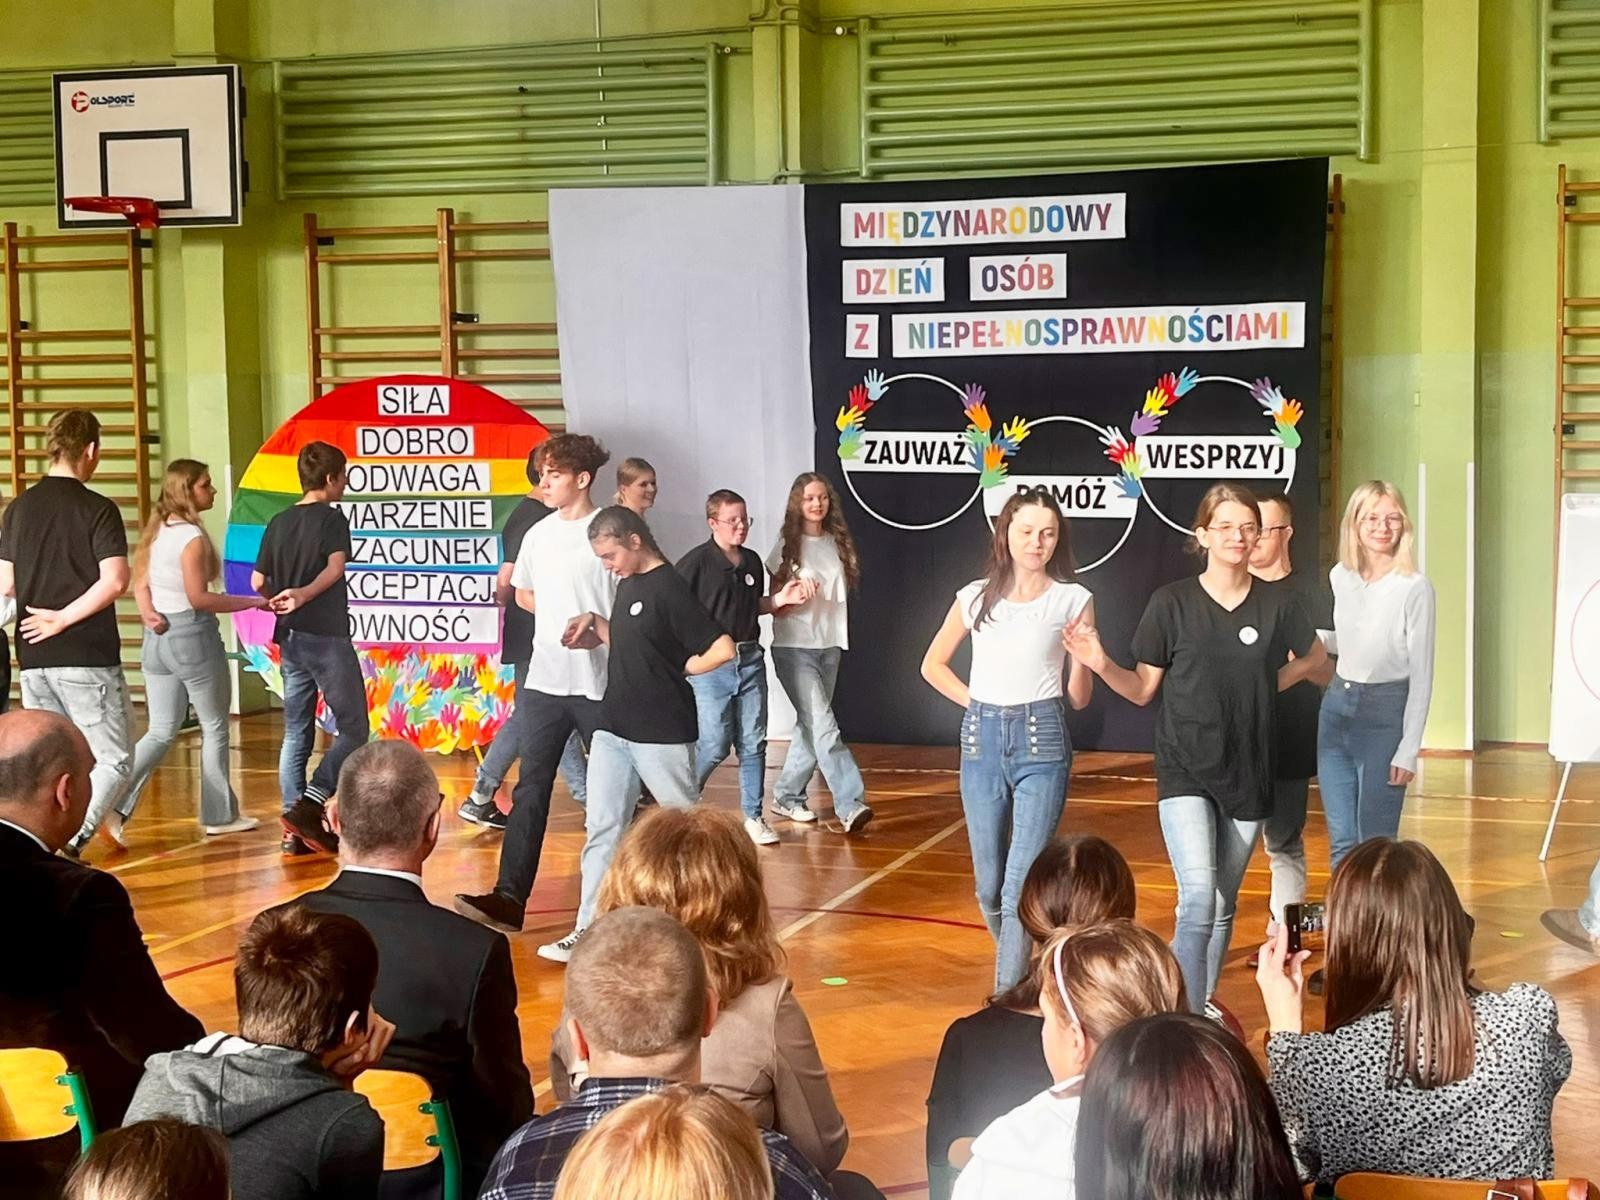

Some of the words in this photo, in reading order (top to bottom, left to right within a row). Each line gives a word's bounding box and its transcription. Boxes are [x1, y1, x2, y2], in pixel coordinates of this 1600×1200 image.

[854, 203, 1112, 242] MIĘDZYNARODOWY
[855, 260, 932, 295] DZIEŃ
[981, 256, 1054, 292] OSÓB
[854, 323, 869, 350] Z
[908, 308, 1288, 350] NIEPEŁNOSPRAWNOŚCIAMI
[382, 386, 445, 414] SIŁA
[362, 427, 468, 455] DOBRO
[863, 434, 966, 466] ZAUWAŻ
[1146, 443, 1285, 475] WESPRZYJ
[348, 463, 480, 492] ODWAGA
[351, 537, 491, 564] ZACUNEK
[345, 572, 491, 602] KCEPTACJ
[347, 607, 471, 642] WNOŚĆ
